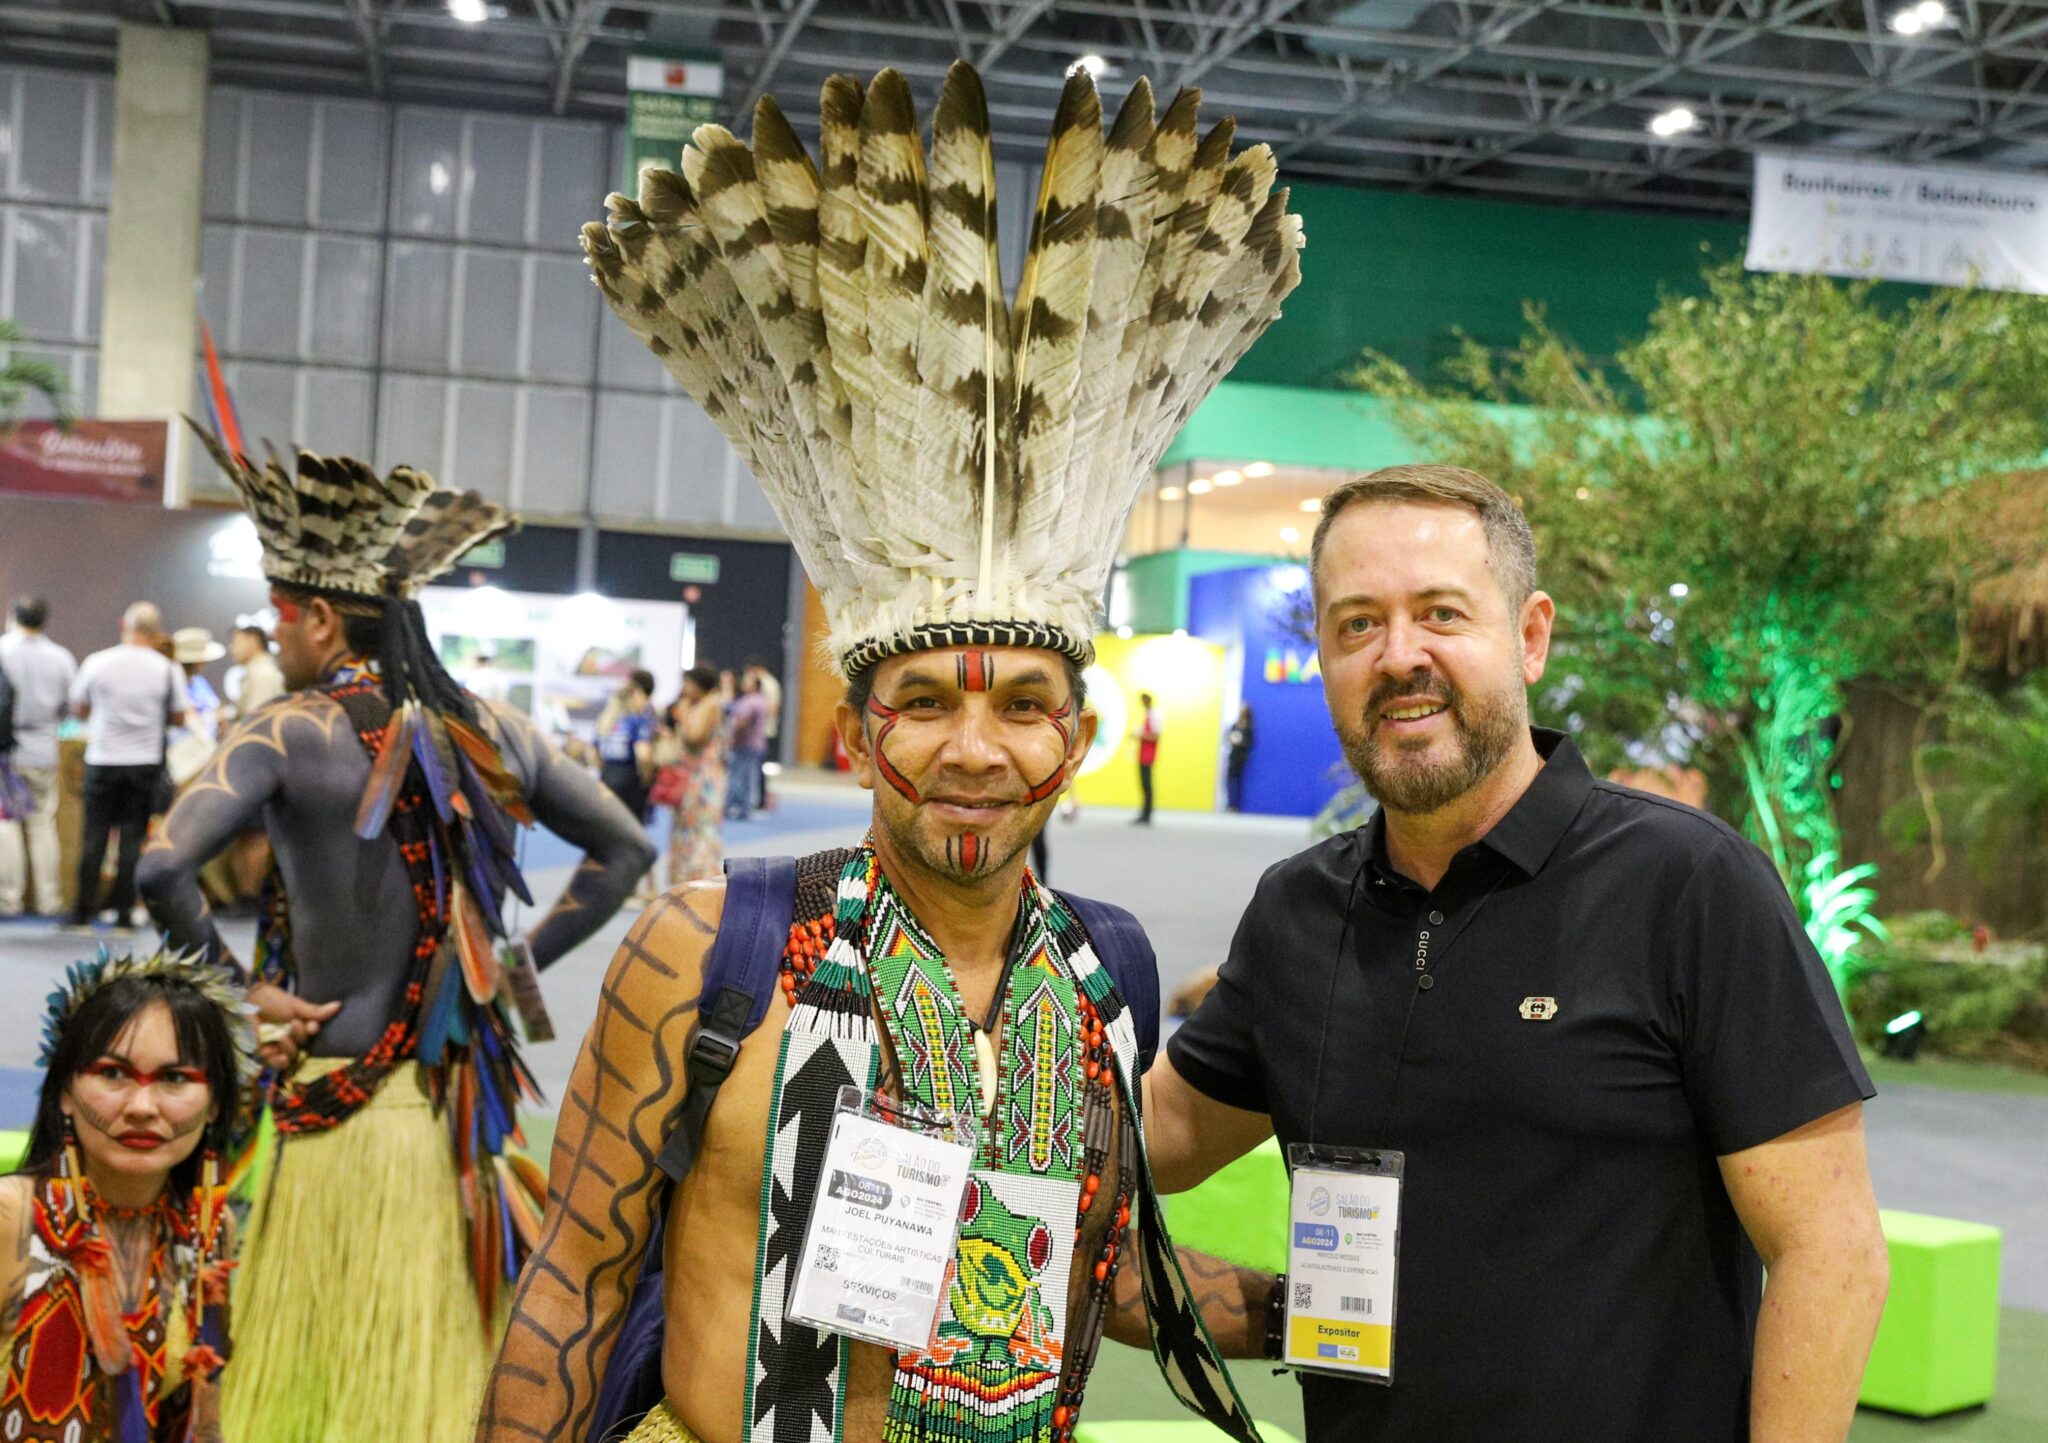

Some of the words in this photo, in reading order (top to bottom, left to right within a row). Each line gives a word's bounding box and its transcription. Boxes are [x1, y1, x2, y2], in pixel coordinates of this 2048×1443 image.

[1415, 930, 1430, 971] GUCCI
[897, 1164, 941, 1187] TURISMO
[835, 1186, 883, 1205] AGO2024
[845, 1206, 871, 1221] JOEL
[874, 1213, 933, 1236] PUYANAWA
[1338, 1206, 1372, 1220] TURISMO
[1302, 1237, 1334, 1248] AGO2024
[858, 1245, 905, 1264] CULTURAIS
[842, 1280, 897, 1301] SERVIÇOS
[1317, 1325, 1361, 1338] Expositor
